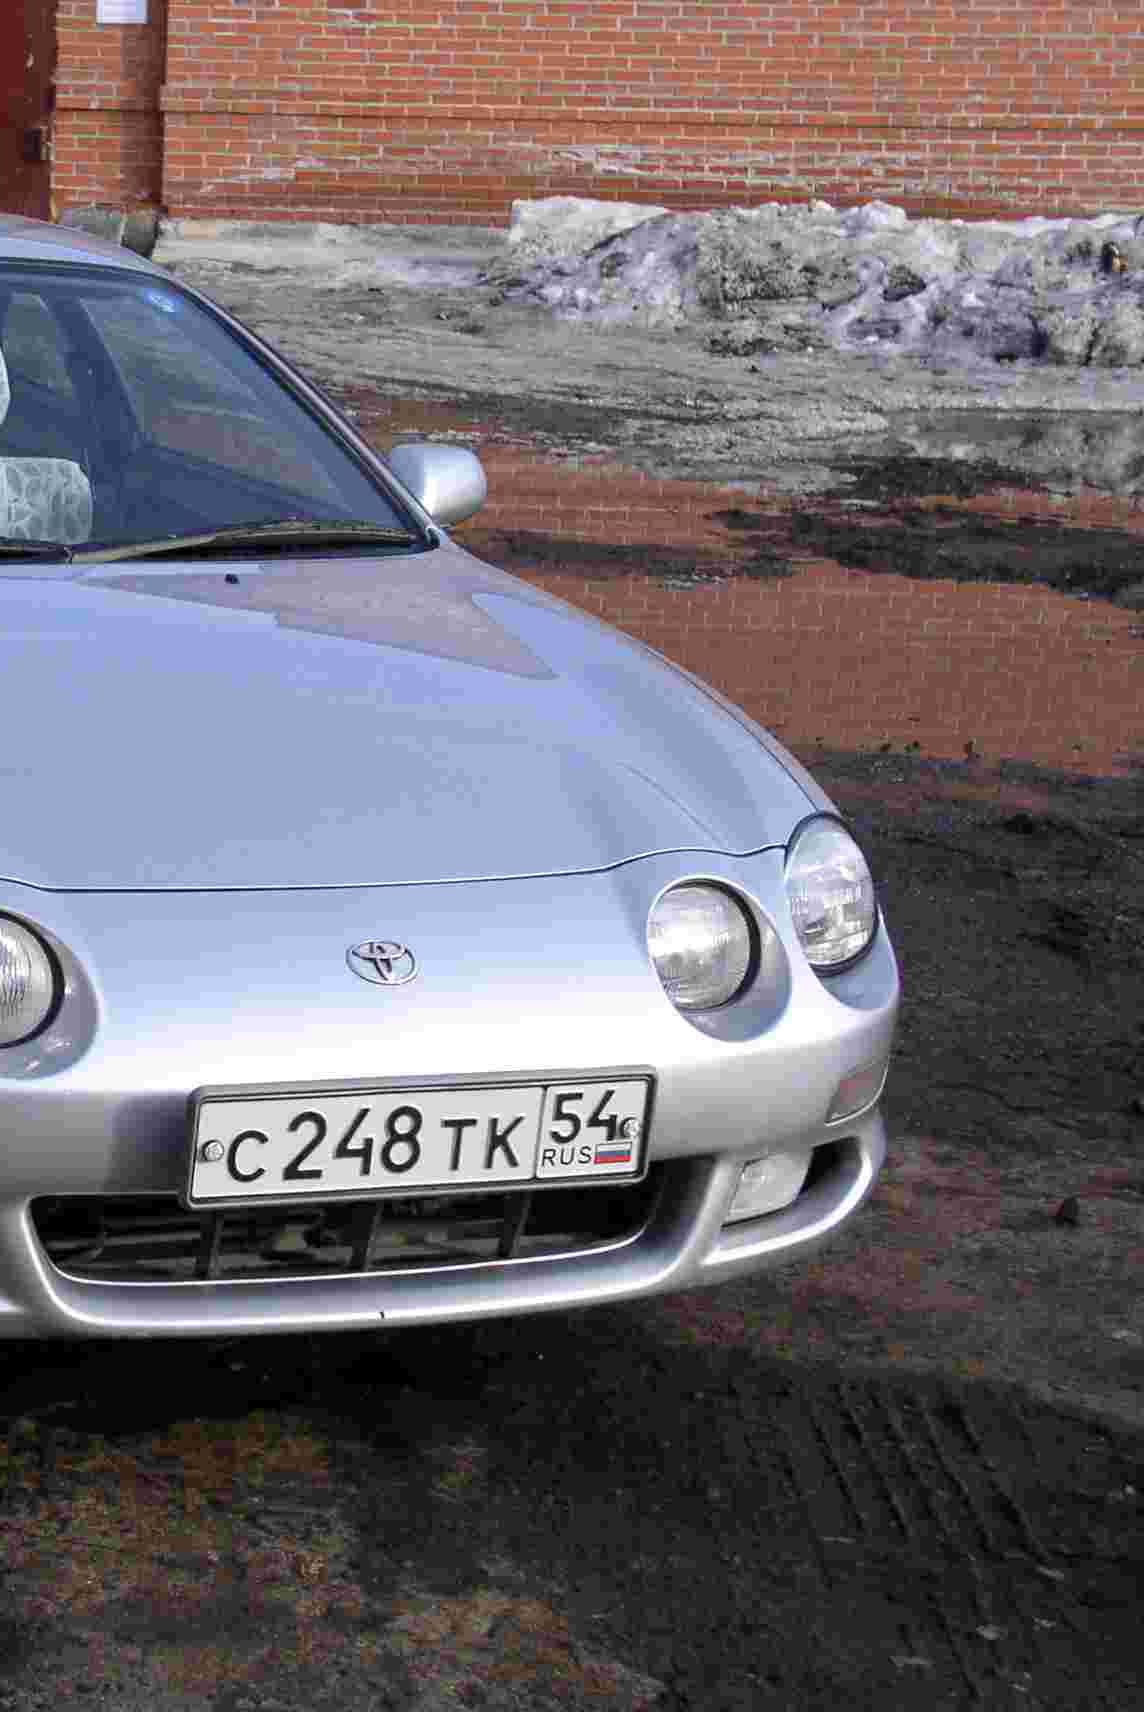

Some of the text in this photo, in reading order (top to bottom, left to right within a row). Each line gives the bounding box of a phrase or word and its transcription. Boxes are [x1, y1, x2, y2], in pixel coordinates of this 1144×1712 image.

[283, 1105, 423, 1181] 248
[549, 1090, 618, 1144] 54
[542, 1145, 593, 1166] RUS
